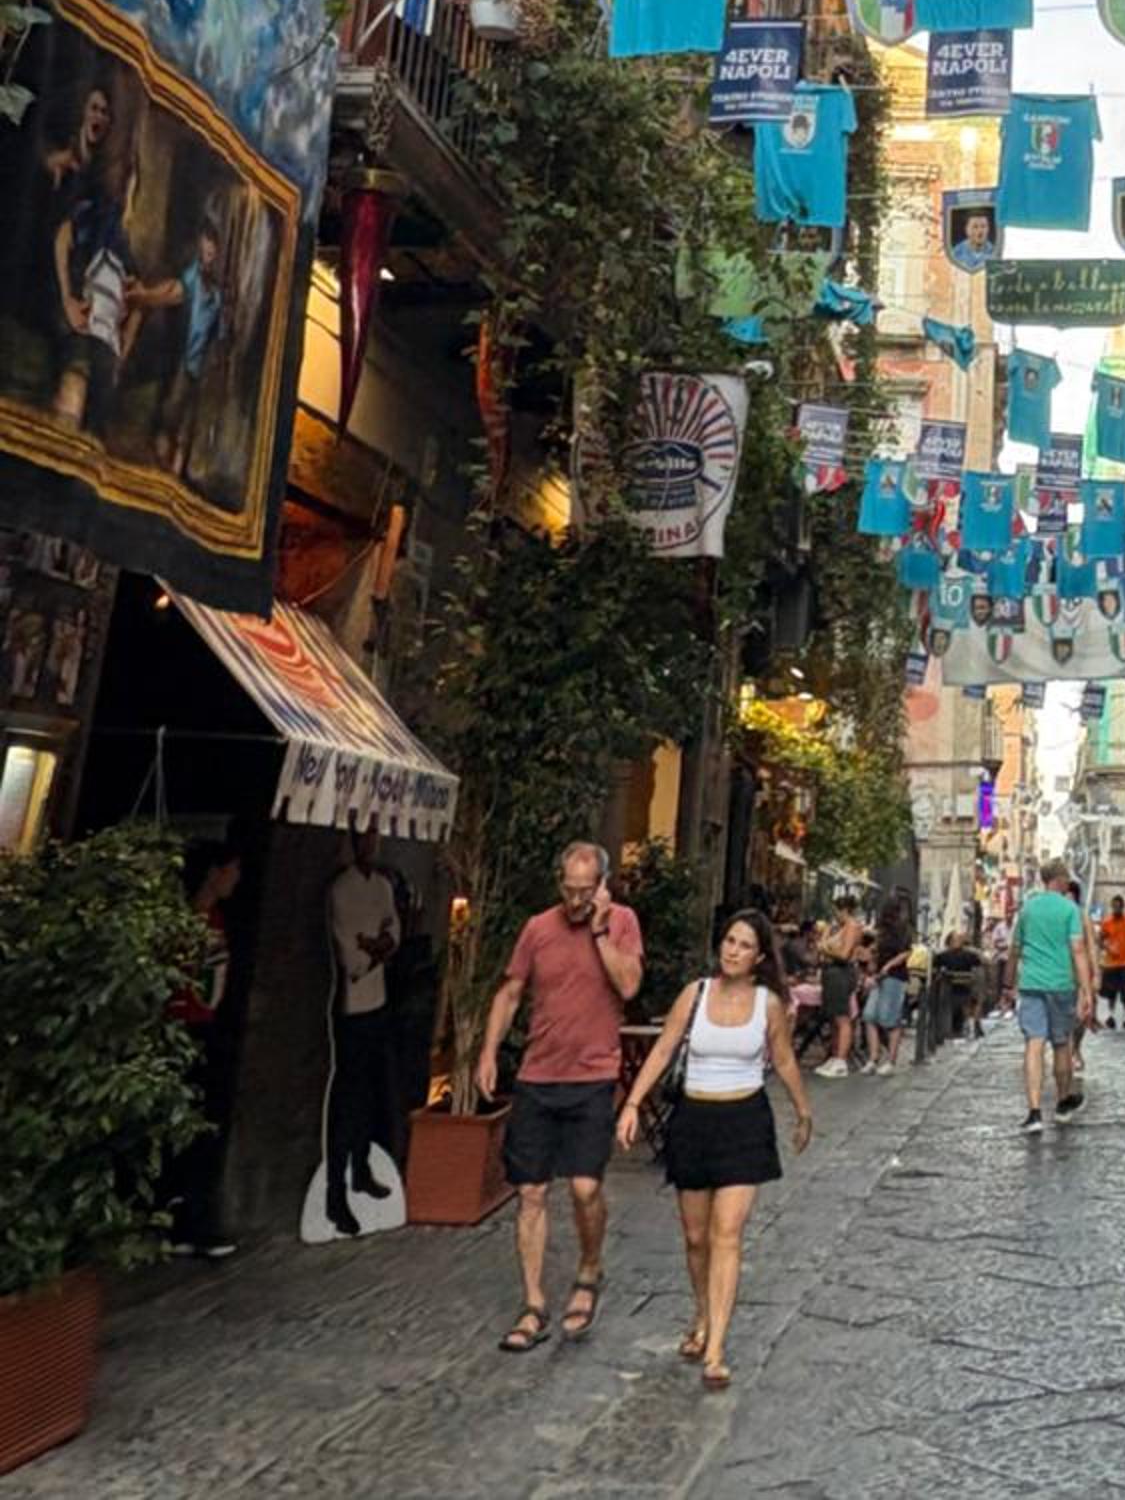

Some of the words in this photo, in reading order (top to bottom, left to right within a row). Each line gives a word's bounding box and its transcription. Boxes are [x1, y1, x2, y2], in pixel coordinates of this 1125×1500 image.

[725, 49, 789, 63] 4EVER
[937, 42, 1004, 59] 4EVER
[720, 65, 791, 80] NAPOLI
[932, 58, 1008, 76] NAPOLI
[939, 585, 963, 607] 10
